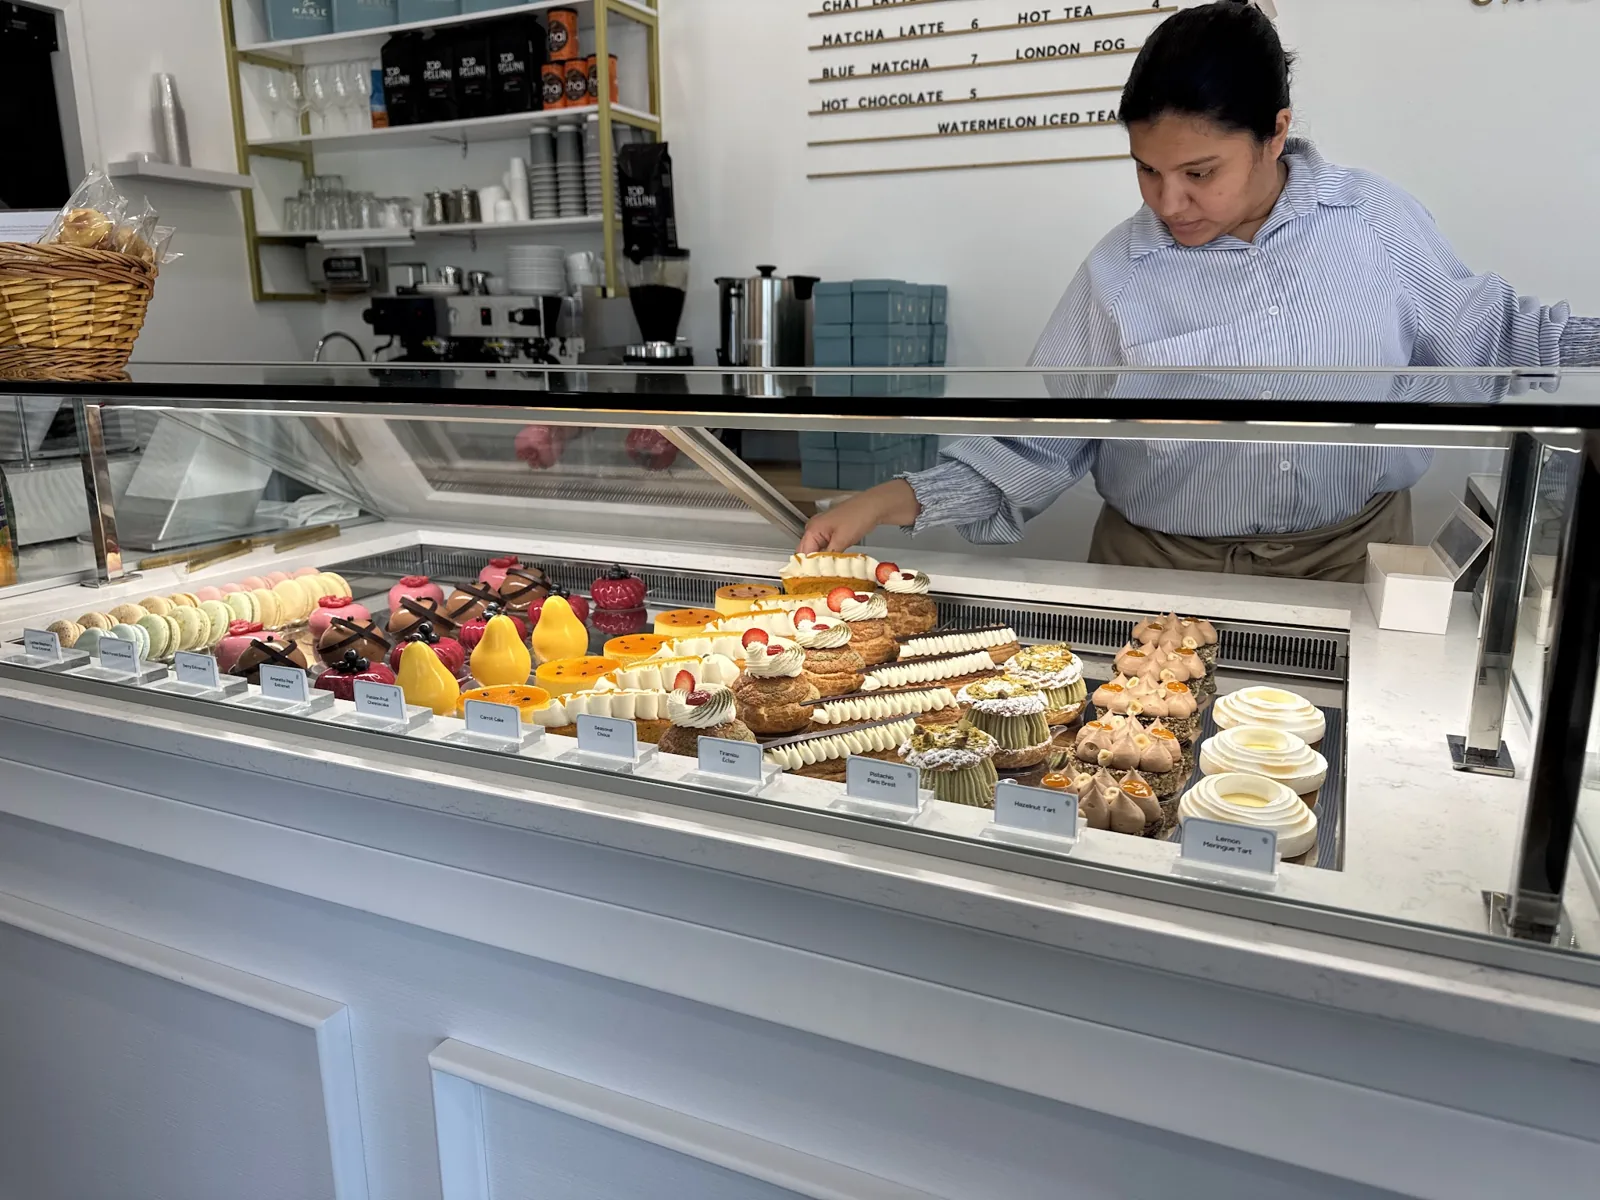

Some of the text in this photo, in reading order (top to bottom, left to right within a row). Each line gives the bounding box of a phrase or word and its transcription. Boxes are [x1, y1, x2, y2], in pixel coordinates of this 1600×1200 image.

[1018, 0, 1160, 24] HOT TEA 4
[822, 18, 978, 46] MATCHA LATTE 6
[1016, 38, 1126, 60] LONDON FOG
[822, 54, 978, 79] BLUE MATCHA 7
[822, 88, 977, 112] HOT CHOCOLATE 5
[938, 110, 1117, 134] WATERMELON ICED TEA
[870, 771, 894, 780] Pistachio
[1014, 801, 1040, 810] Hazelnut
[1203, 841, 1252, 855] Meringue Tart
[1215, 835, 1241, 845] Lemon
